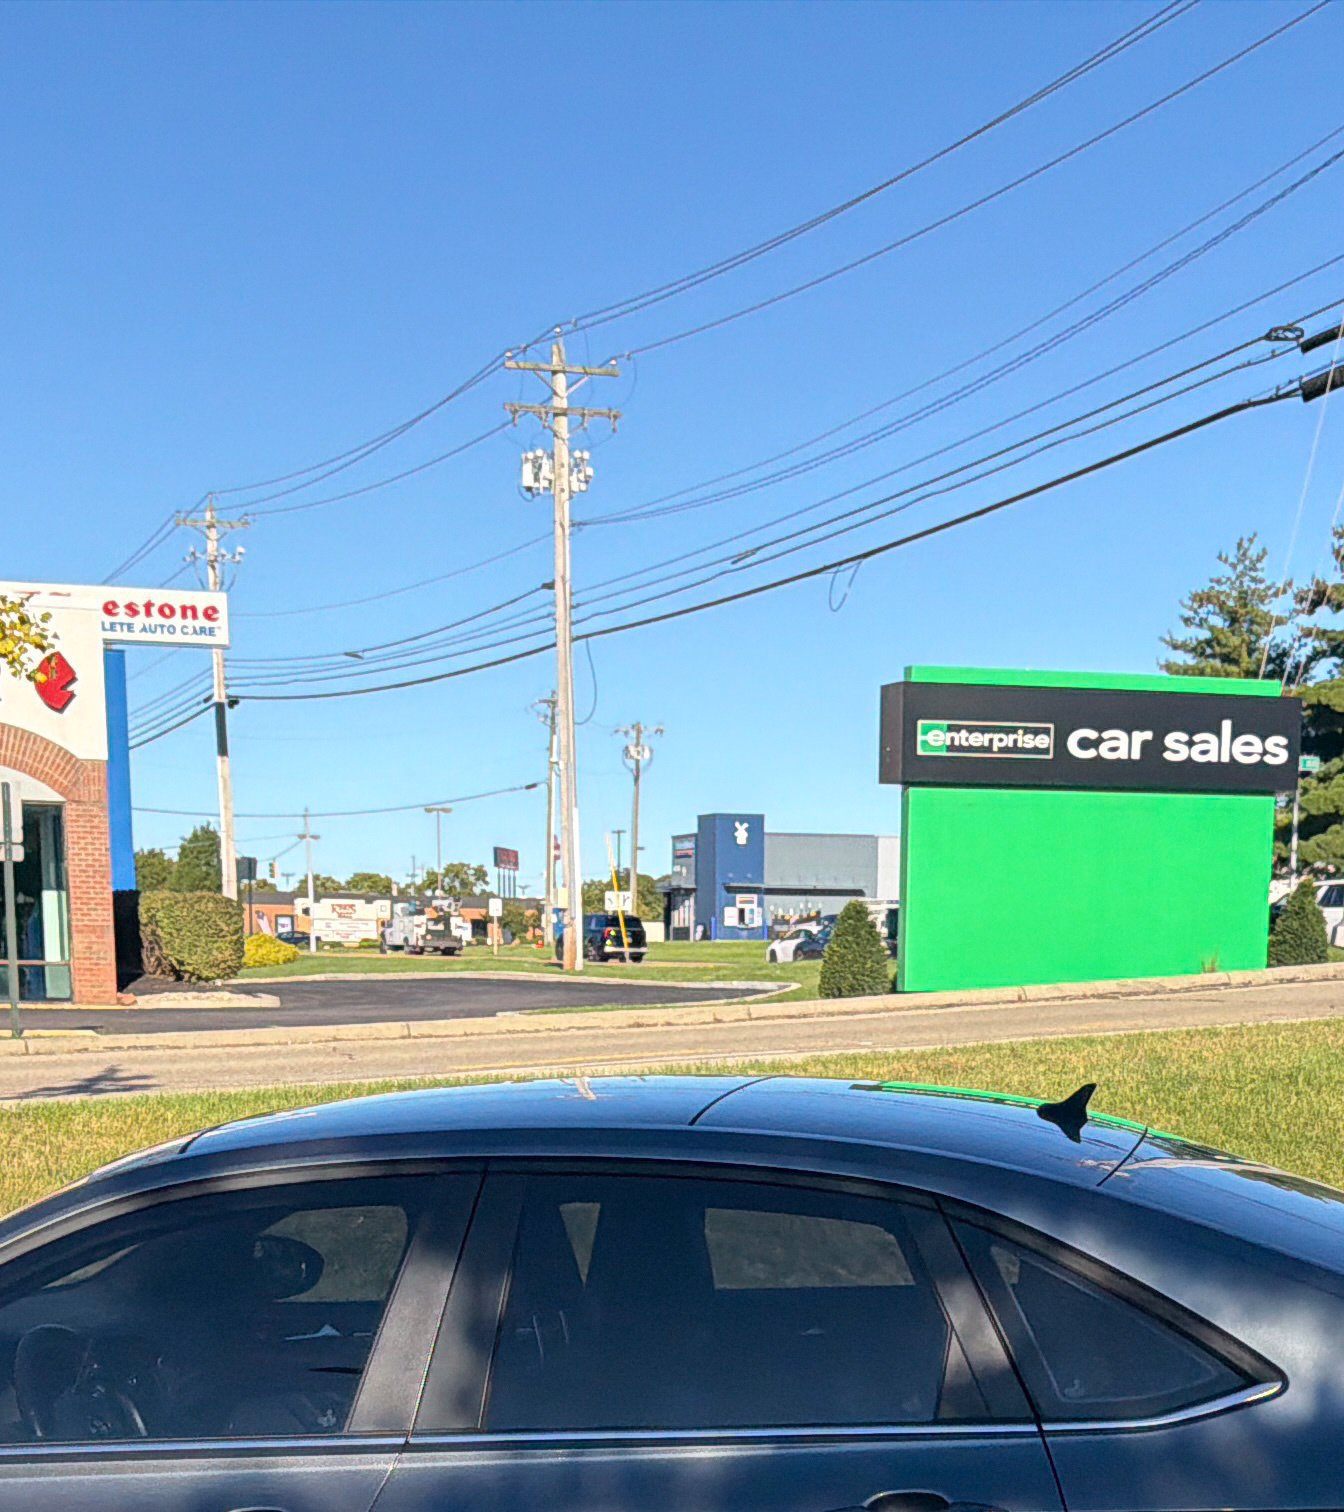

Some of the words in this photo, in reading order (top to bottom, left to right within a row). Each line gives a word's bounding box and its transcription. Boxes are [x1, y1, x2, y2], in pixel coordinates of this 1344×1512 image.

[139, 623, 176, 635] AUTO
[181, 625, 216, 637] CARE
[926, 728, 1050, 752] enterprise
[1066, 728, 1153, 760] car
[1162, 719, 1289, 765] sales
